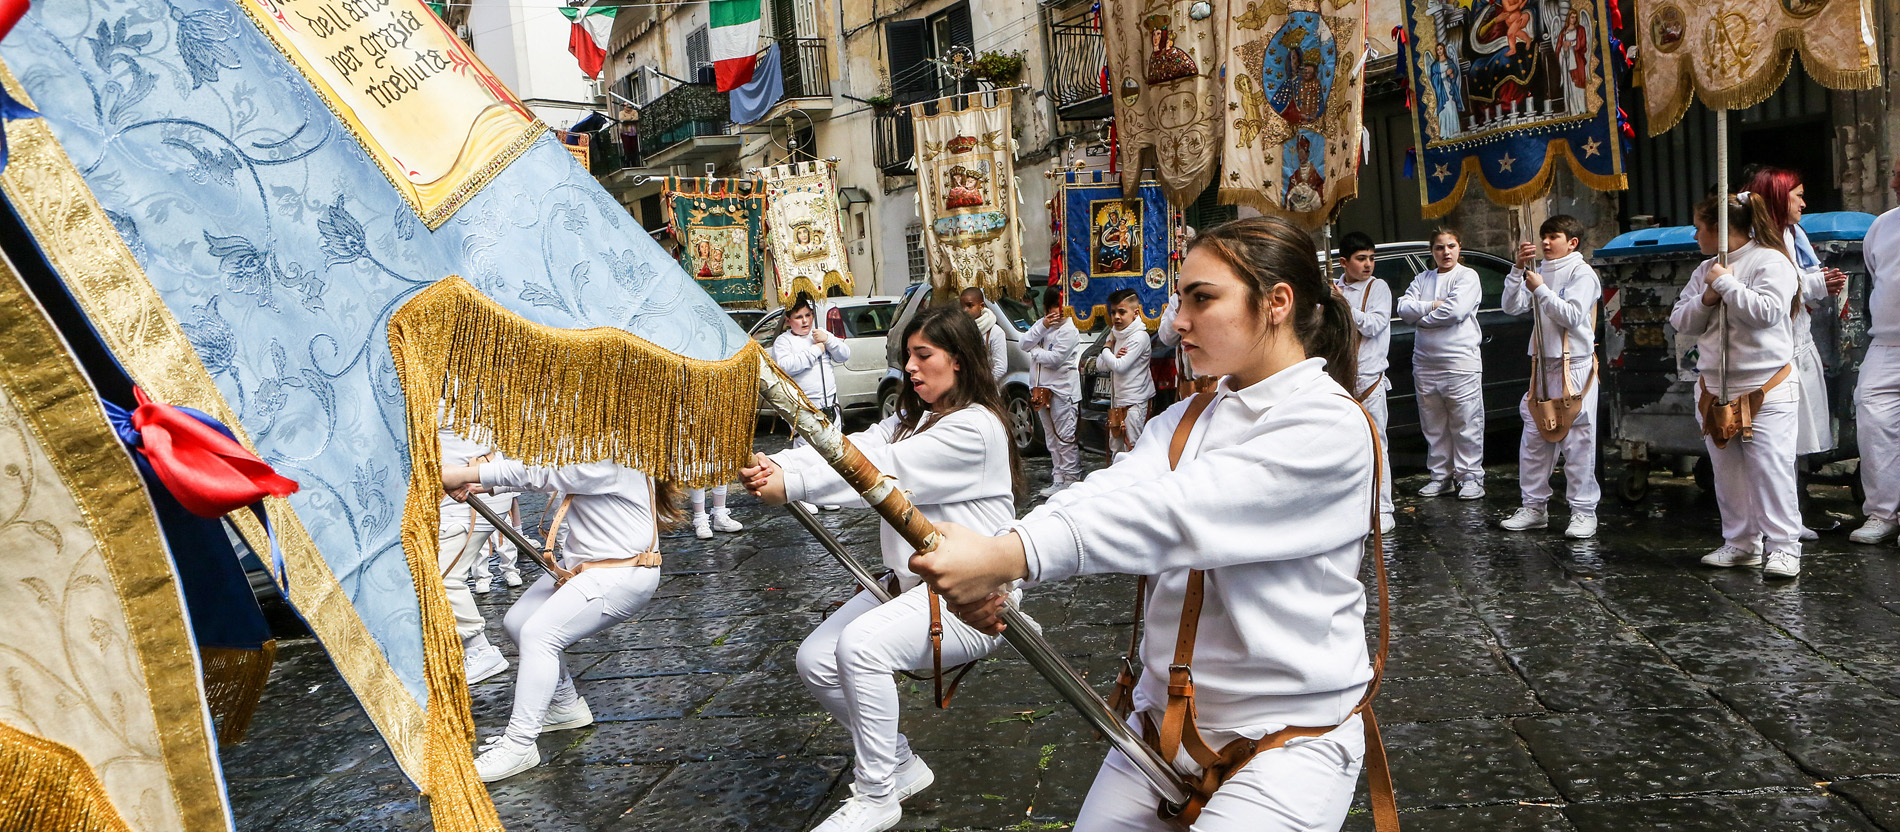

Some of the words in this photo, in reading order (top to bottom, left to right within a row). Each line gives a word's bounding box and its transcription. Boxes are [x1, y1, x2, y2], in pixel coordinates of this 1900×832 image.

[324, 45, 364, 86] per
[360, 10, 424, 69] grazia
[365, 48, 452, 109] ricevuta
